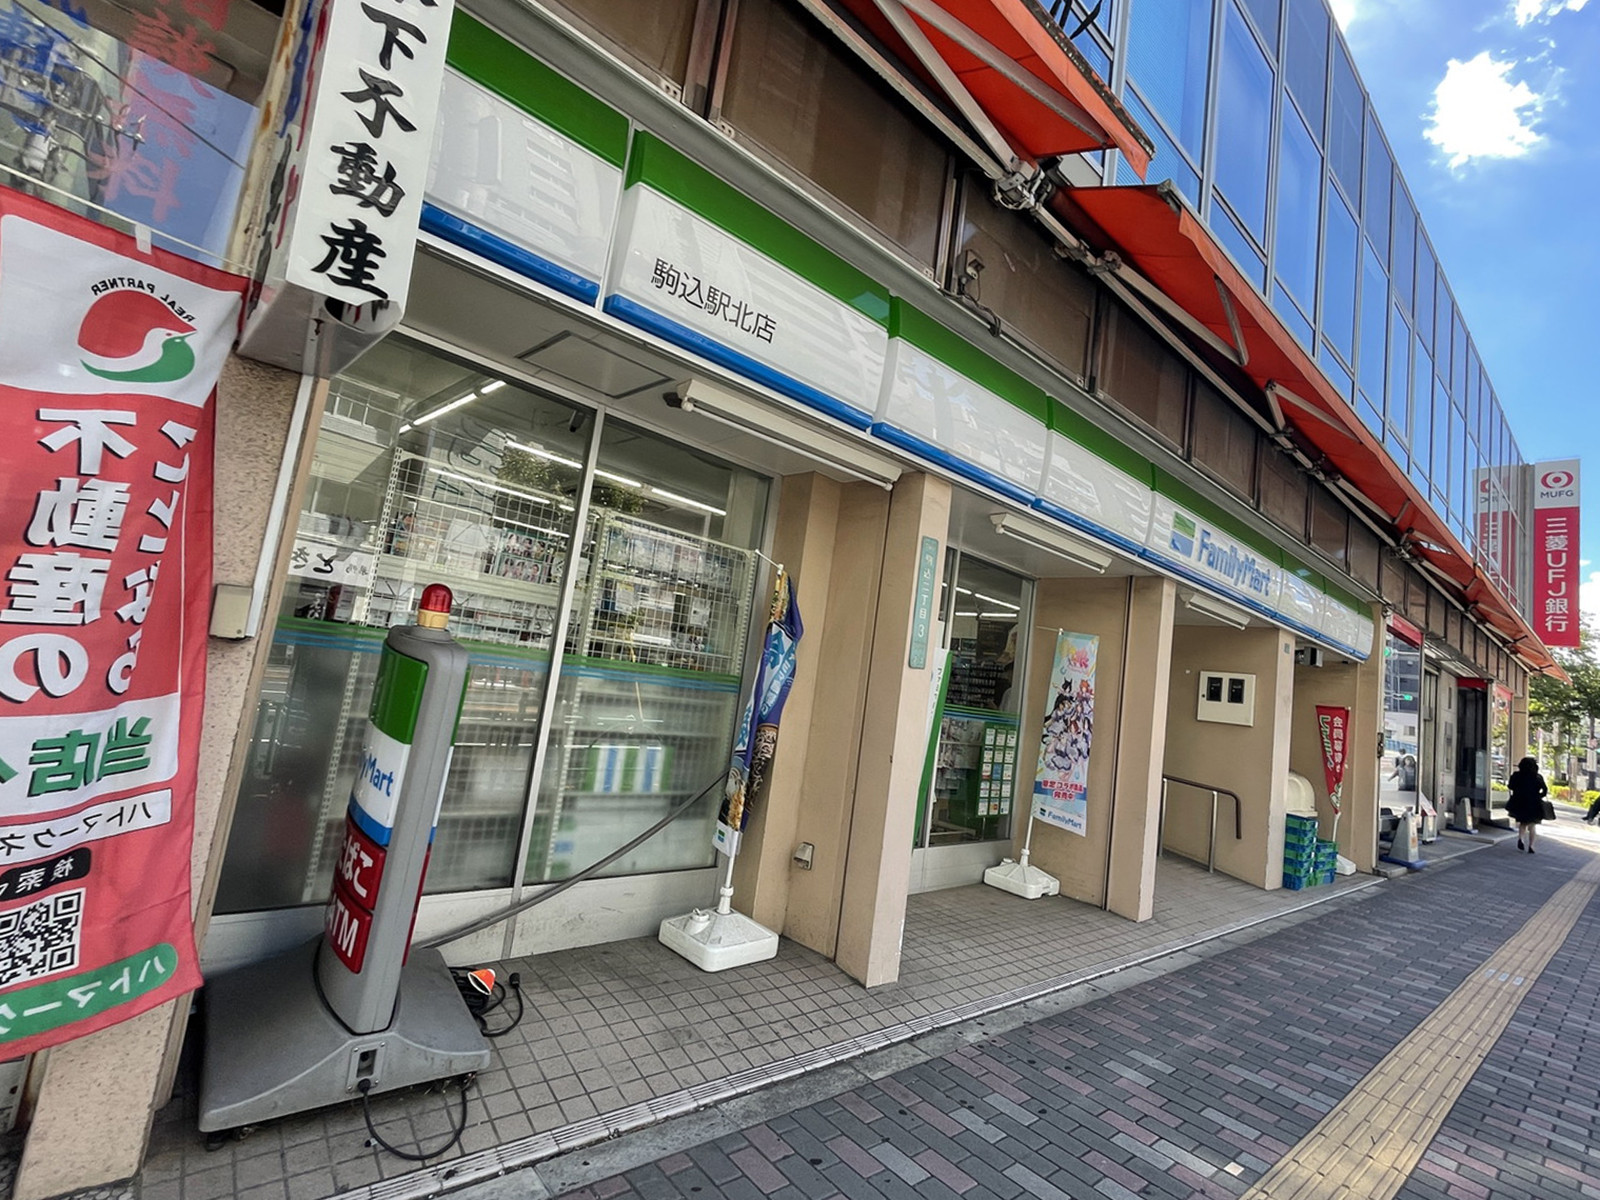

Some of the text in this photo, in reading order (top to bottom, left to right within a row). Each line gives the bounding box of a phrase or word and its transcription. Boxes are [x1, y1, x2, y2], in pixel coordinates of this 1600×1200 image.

[311, 0, 438, 299] 下不動産
[650, 257, 777, 344] 駒込駅北店
[1540, 489, 1574, 499] MUFG
[1197, 528, 1271, 597] FamilyMart
[1545, 517, 1569, 632] 三菱UFJ銀行
[1047, 811, 1083, 830] FamilyMart
